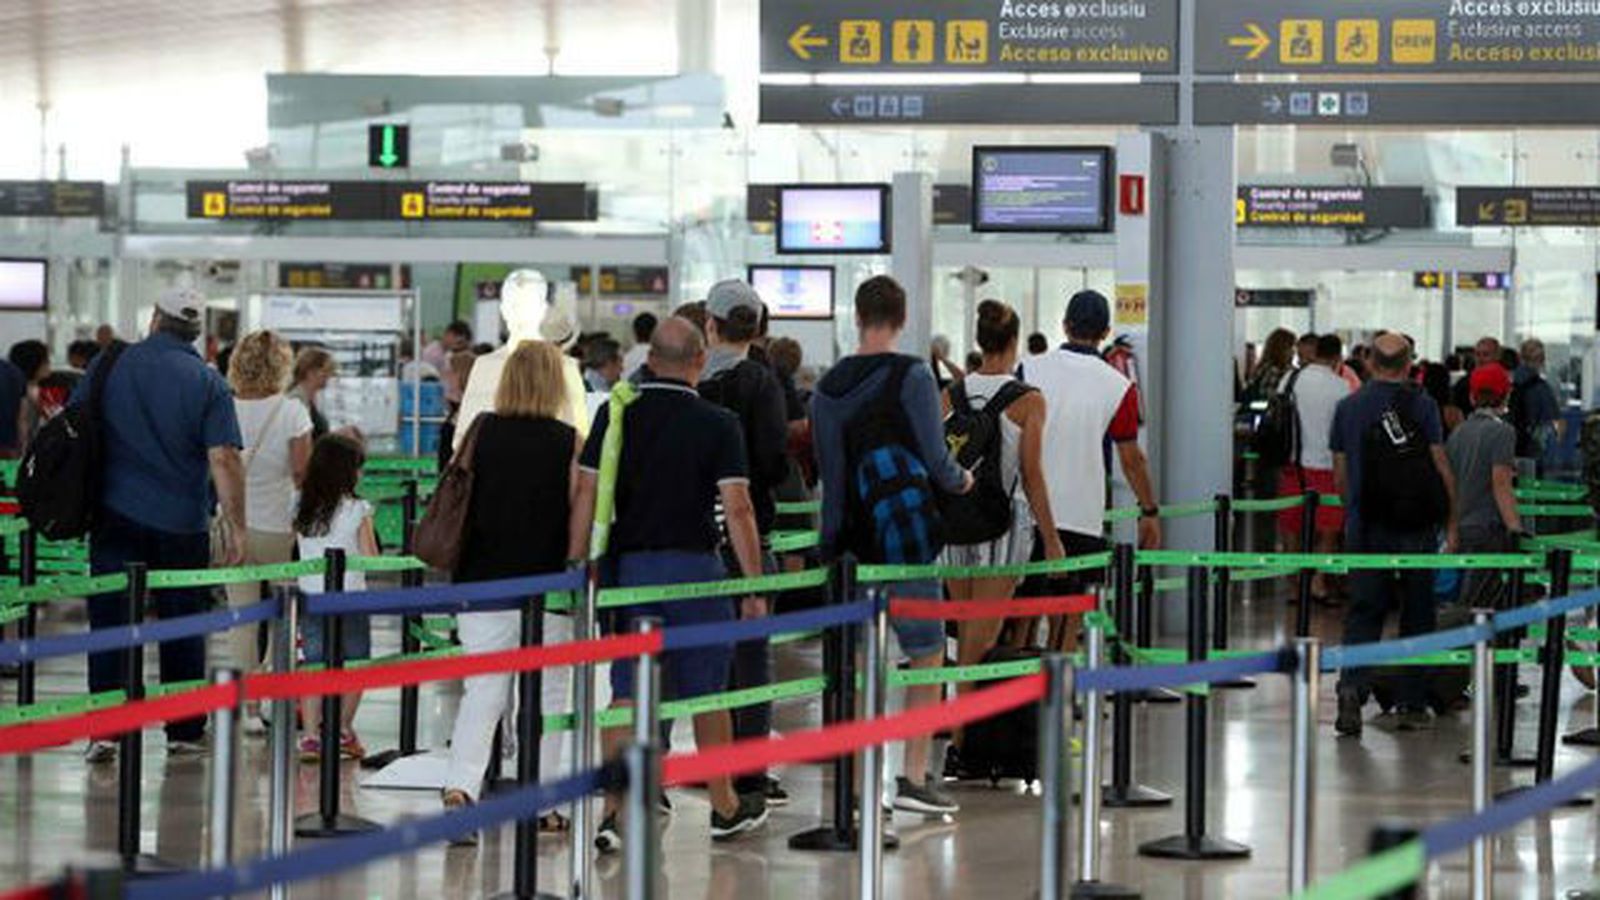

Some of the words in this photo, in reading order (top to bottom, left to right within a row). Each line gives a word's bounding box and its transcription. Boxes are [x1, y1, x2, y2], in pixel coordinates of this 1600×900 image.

[1065, 0, 1146, 17] exclusiu
[999, 21, 1068, 39] Exclusive
[1072, 25, 1124, 38] access
[1448, 20, 1521, 38] Exclusive
[1524, 23, 1582, 38] access
[1395, 34, 1433, 48] CREW
[1000, 43, 1071, 61] Acceso
[1076, 42, 1169, 61] exclusivo
[1449, 42, 1522, 61] Acceso
[1250, 187, 1290, 199] Control
[1293, 188, 1307, 199] de
[1251, 210, 1290, 222] Control
[1293, 211, 1307, 222] de
[1310, 211, 1365, 225] seguridad
